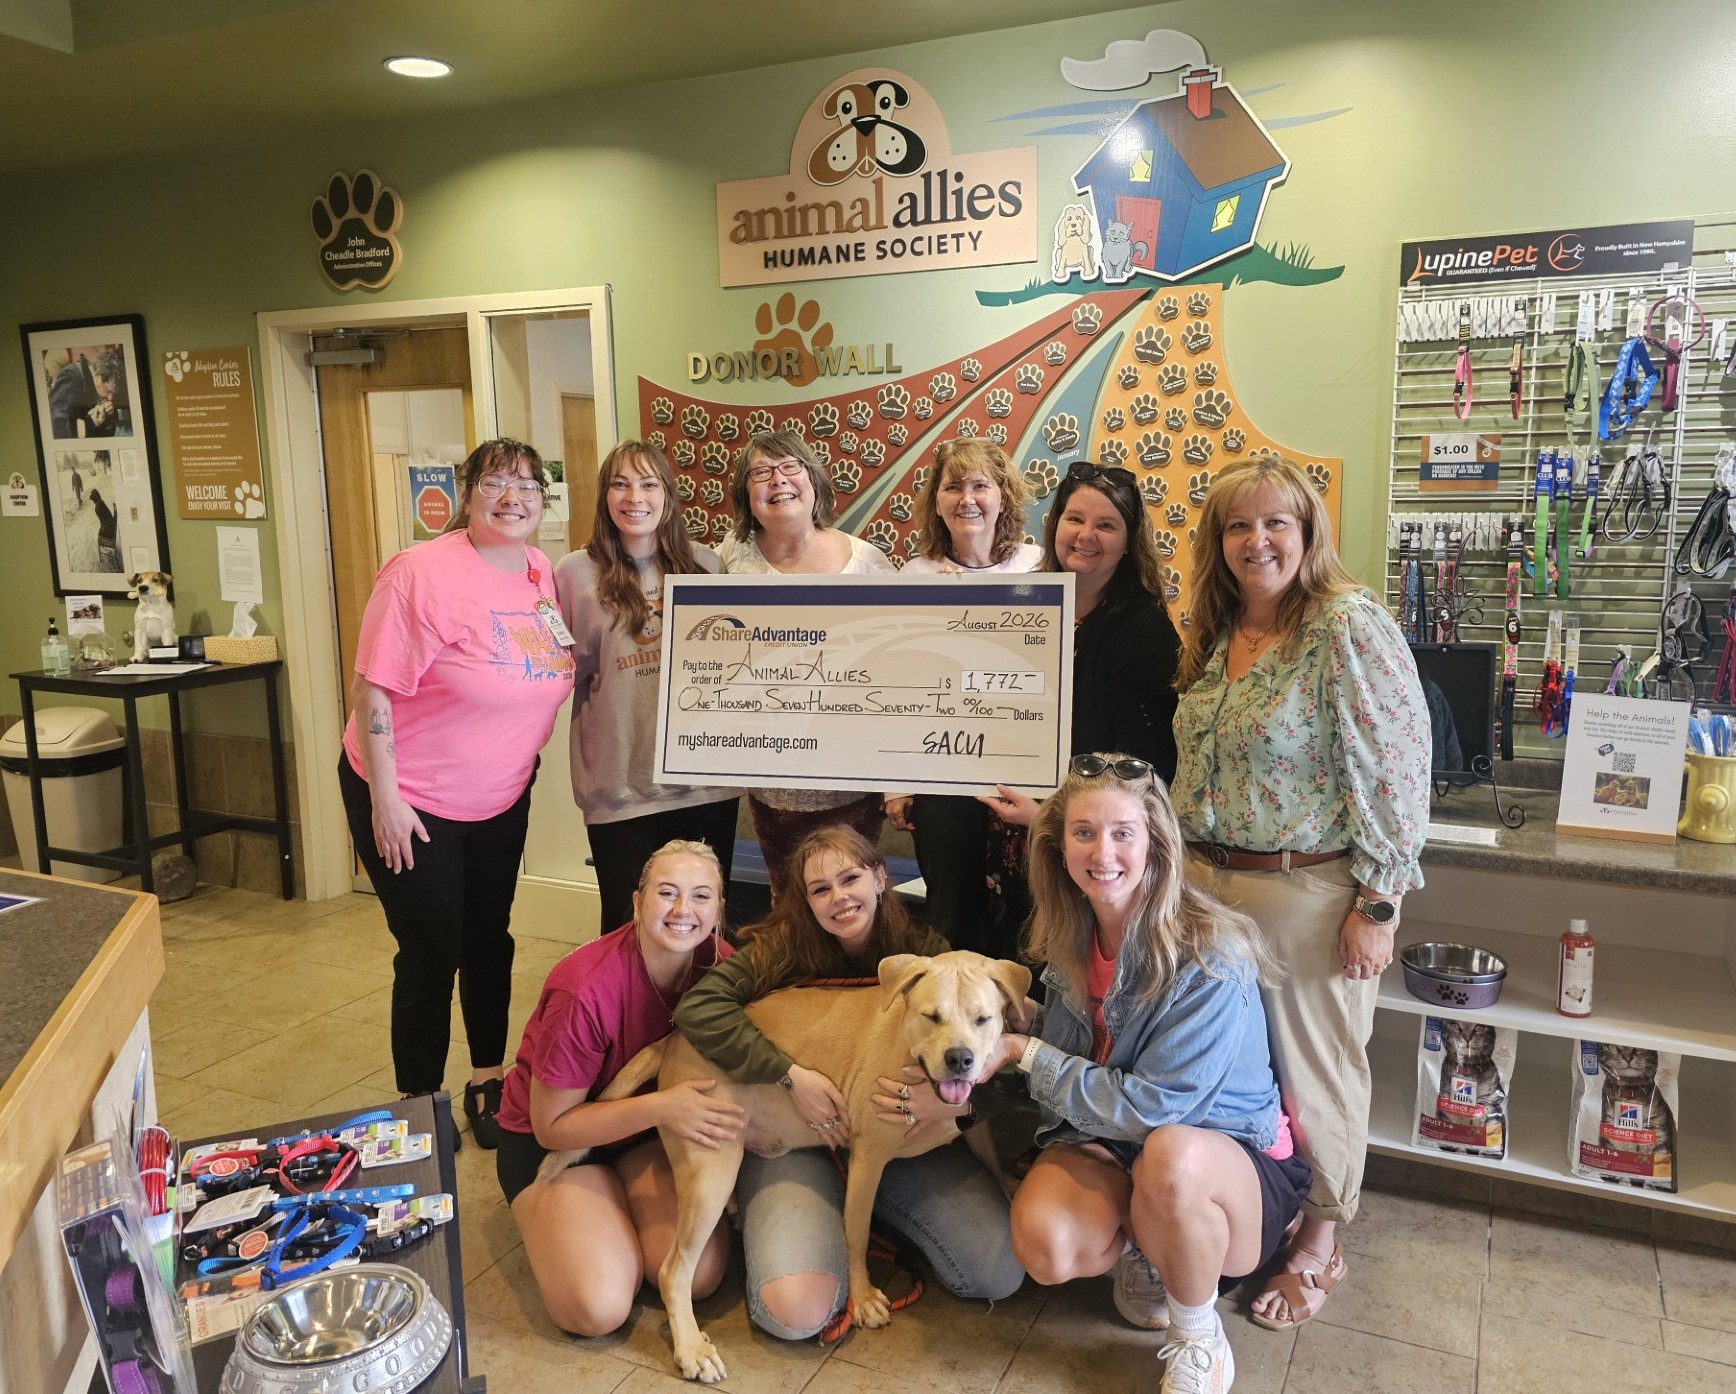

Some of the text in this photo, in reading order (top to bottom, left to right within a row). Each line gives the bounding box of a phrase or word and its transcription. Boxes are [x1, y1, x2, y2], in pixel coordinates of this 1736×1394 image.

[728, 168, 1023, 246] animal allies
[347, 237, 365, 247] John
[1595, 245, 1618, 253] Proudly
[1653, 239, 1686, 247] Hampshire
[325, 246, 390, 260] Cheadle Bradford
[763, 230, 983, 269] HUMANE SOCIETY
[1623, 249, 1638, 257] since
[1446, 267, 1488, 276] GUARANTEED
[687, 343, 902, 381] DONOR WALL
[212, 371, 241, 388] RULES
[1057, 449, 1080, 461] January
[1433, 444, 1469, 456] $1.00
[416, 473, 447, 482] SLOW
[185, 485, 228, 500] WELCOME
[188, 501, 231, 511] ENJOY YOUR VISIT
[1000, 611, 1049, 628] 2026
[1508, 619, 1517, 633] 6
[711, 626, 827, 646] ShareAdvantage
[1024, 634, 1046, 645] Date
[683, 659, 723, 673] Pay to the
[691, 675, 722, 685] order of
[945, 678, 951, 689] $
[1013, 709, 1044, 721] Dollars
[1587, 708, 1676, 726] Help the Animals!
[678, 731, 818, 754] myshareadvantage.com
[1440, 1101, 1468, 1113] SCIENCE
[1421, 1115, 1441, 1127] ADULT
[1618, 1118, 1638, 1128] Hill's
[1603, 1127, 1633, 1138] SCIENCE
[1582, 1144, 1605, 1156] ADULT
